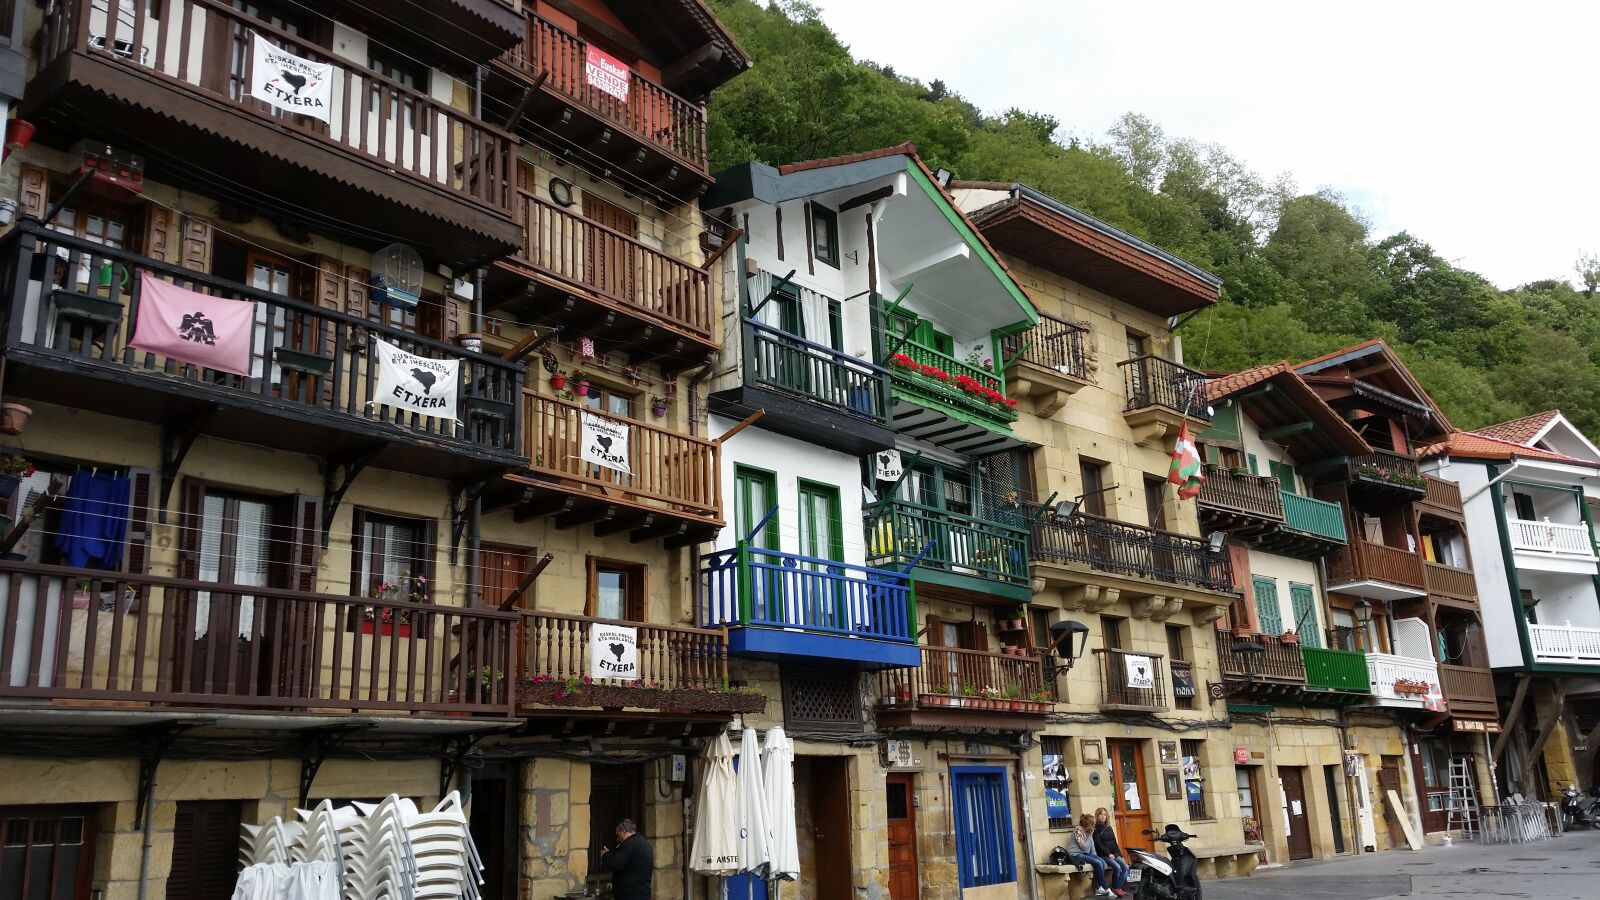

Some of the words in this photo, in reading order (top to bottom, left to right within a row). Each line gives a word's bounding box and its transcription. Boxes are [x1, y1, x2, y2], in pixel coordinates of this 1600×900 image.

[587, 64, 628, 92] VENDE
[600, 58, 627, 80] Euskadi
[263, 82, 323, 107] ETXERA
[392, 384, 447, 408] ETXERA
[599, 658, 635, 673] ETXERA
[716, 855, 738, 864] AMSTE
